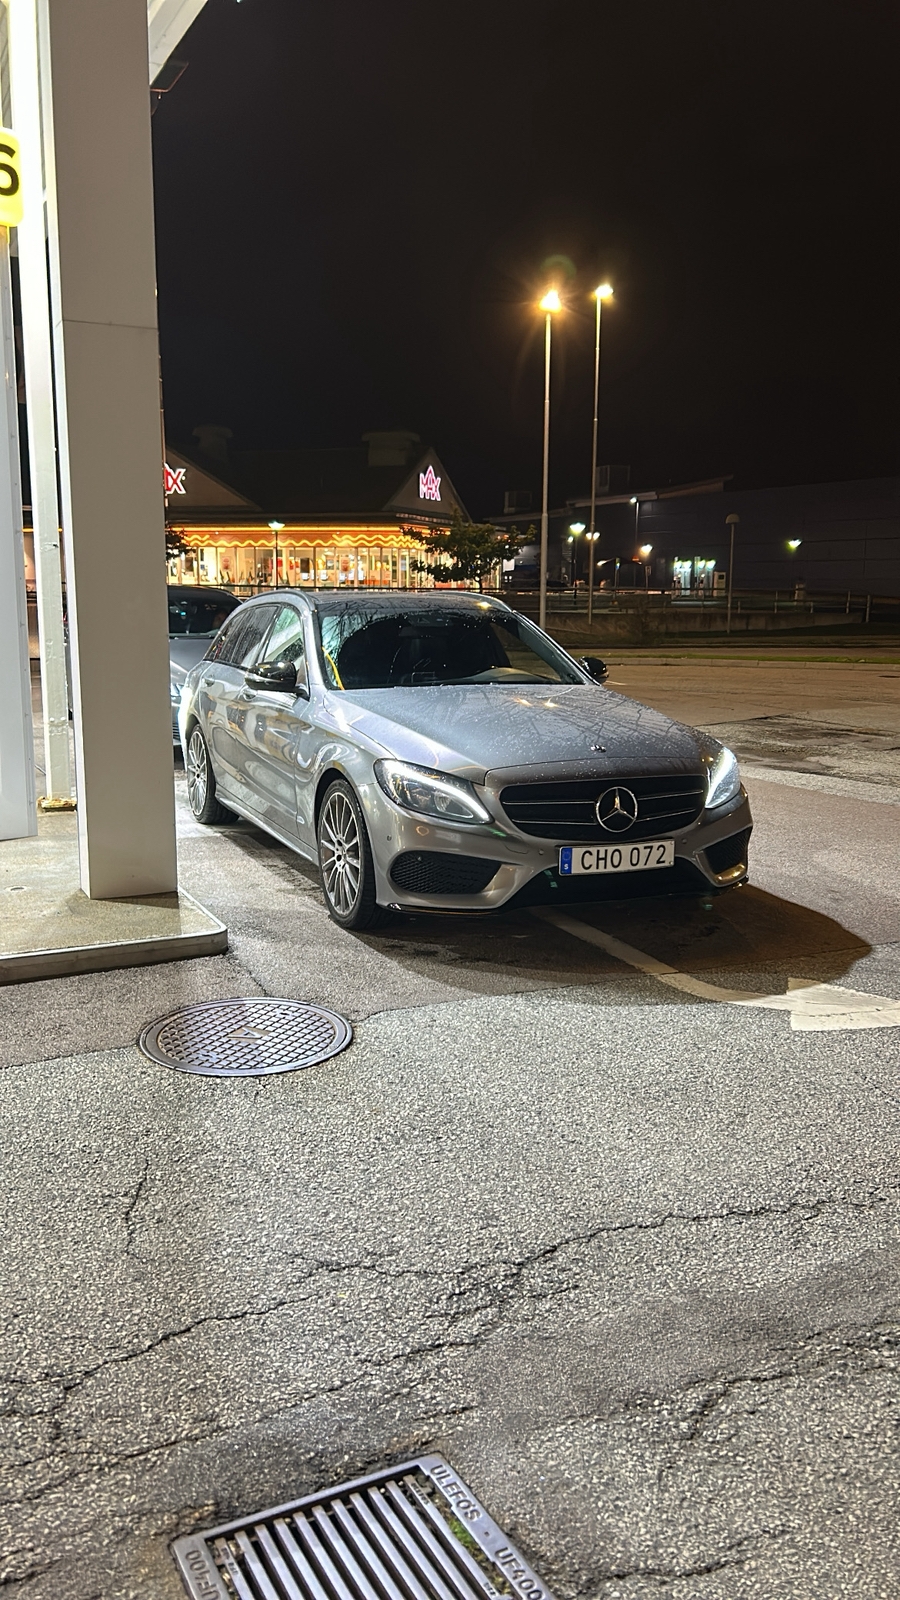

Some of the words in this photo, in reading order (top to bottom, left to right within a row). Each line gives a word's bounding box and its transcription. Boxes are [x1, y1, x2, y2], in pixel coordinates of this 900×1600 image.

[420, 465, 441, 501] MAX
[581, 848, 622, 870] CHO
[630, 844, 666, 867] 072
